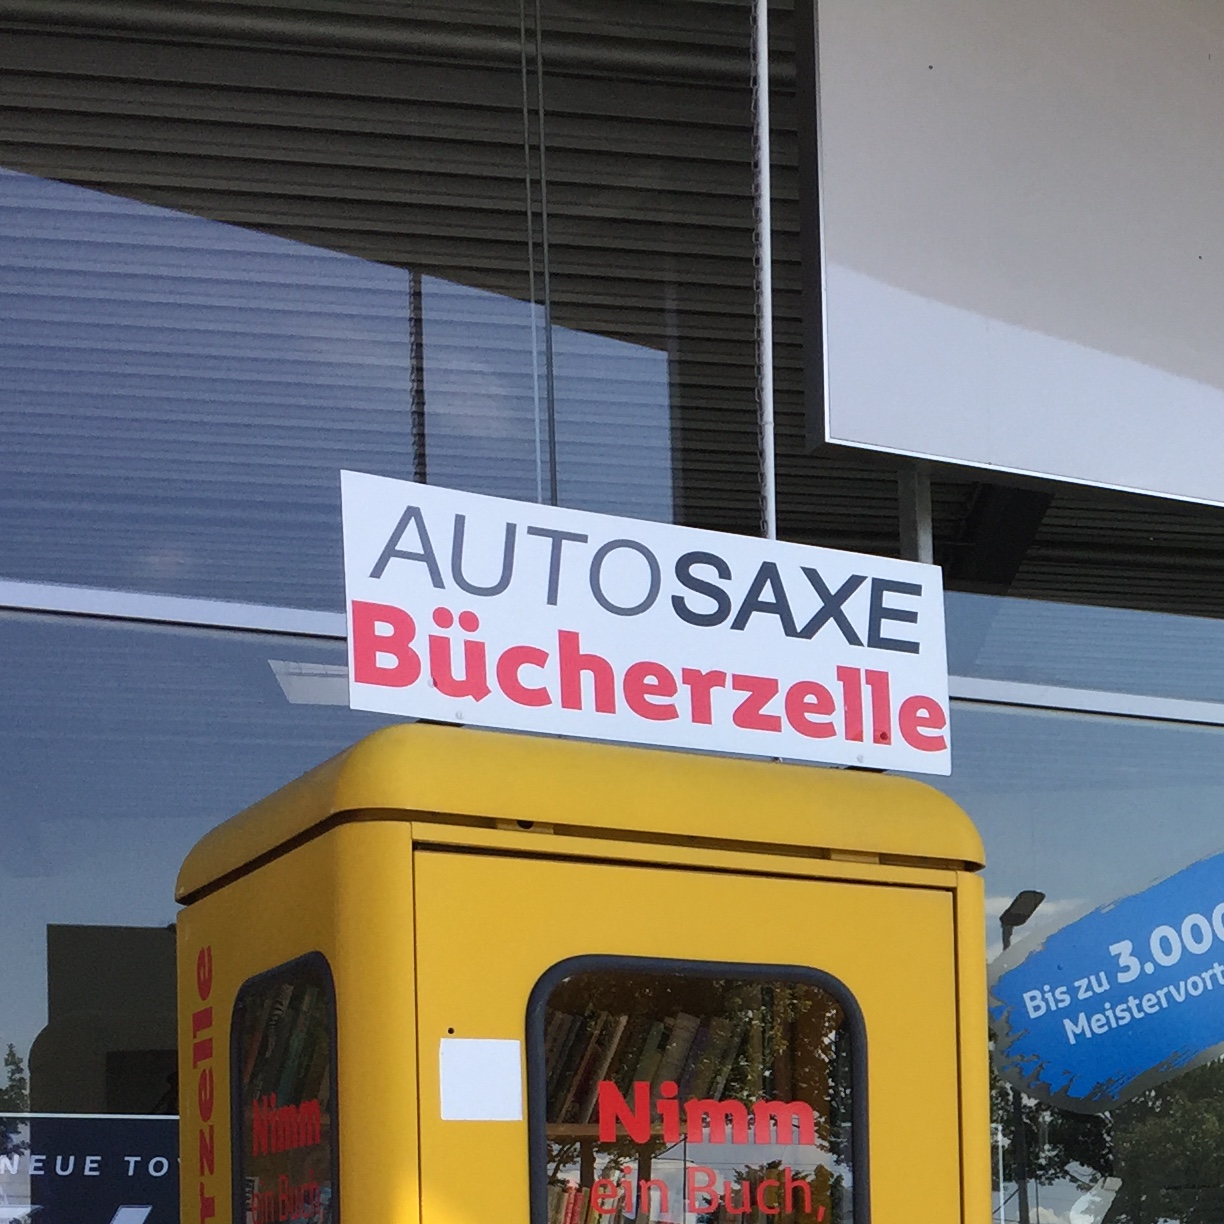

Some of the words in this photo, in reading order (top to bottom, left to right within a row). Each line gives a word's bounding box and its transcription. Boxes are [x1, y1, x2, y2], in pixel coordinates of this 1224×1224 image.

[369, 504, 923, 654] AUTOSAXE
[350, 599, 949, 752] Bücherzelle
[1022, 983, 1072, 1020] Bis
[1075, 970, 1111, 1001] zu
[252, 1092, 321, 1158] Nimm
[597, 1080, 816, 1145] Nimm
[124, 1155, 182, 1178] TO
[590, 1167, 670, 1215] ein
[686, 1165, 827, 1223] Buch,
